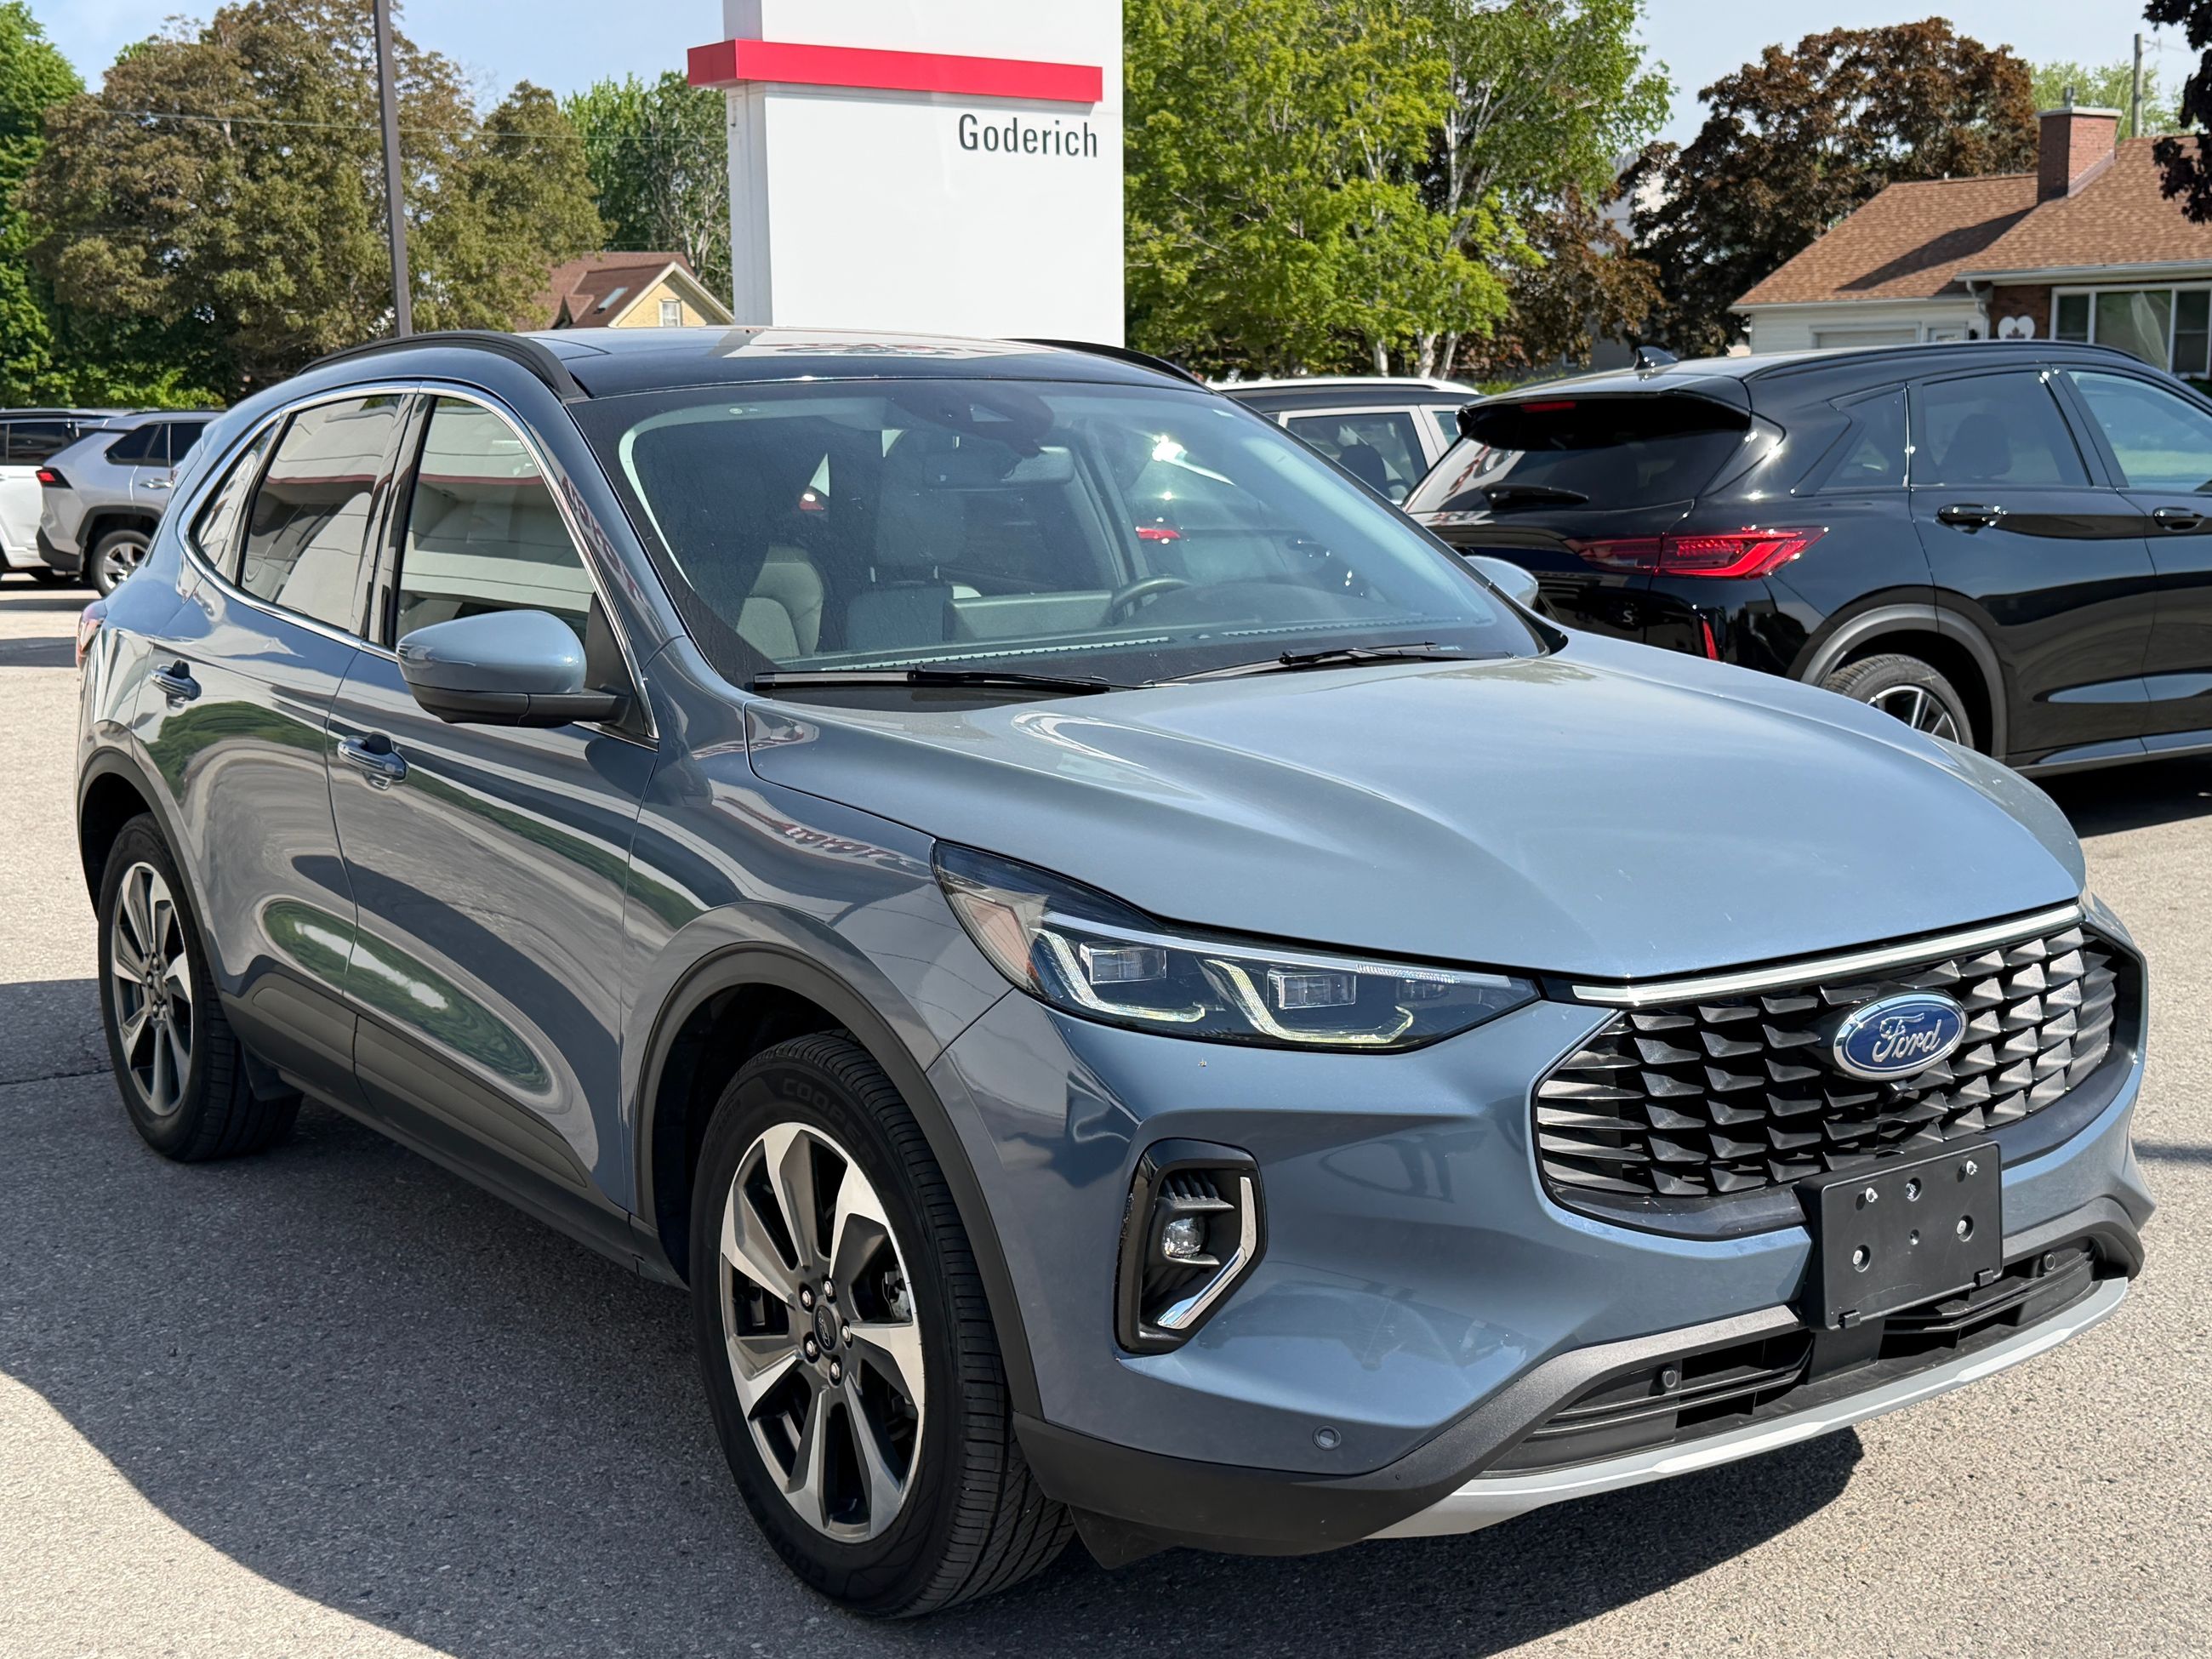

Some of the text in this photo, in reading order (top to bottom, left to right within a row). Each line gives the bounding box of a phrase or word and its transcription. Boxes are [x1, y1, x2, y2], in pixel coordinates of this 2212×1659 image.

[959, 113, 1097, 158] Goderich
[1872, 1012, 1942, 1063] Ford
[783, 1077, 878, 1165] COOPER
